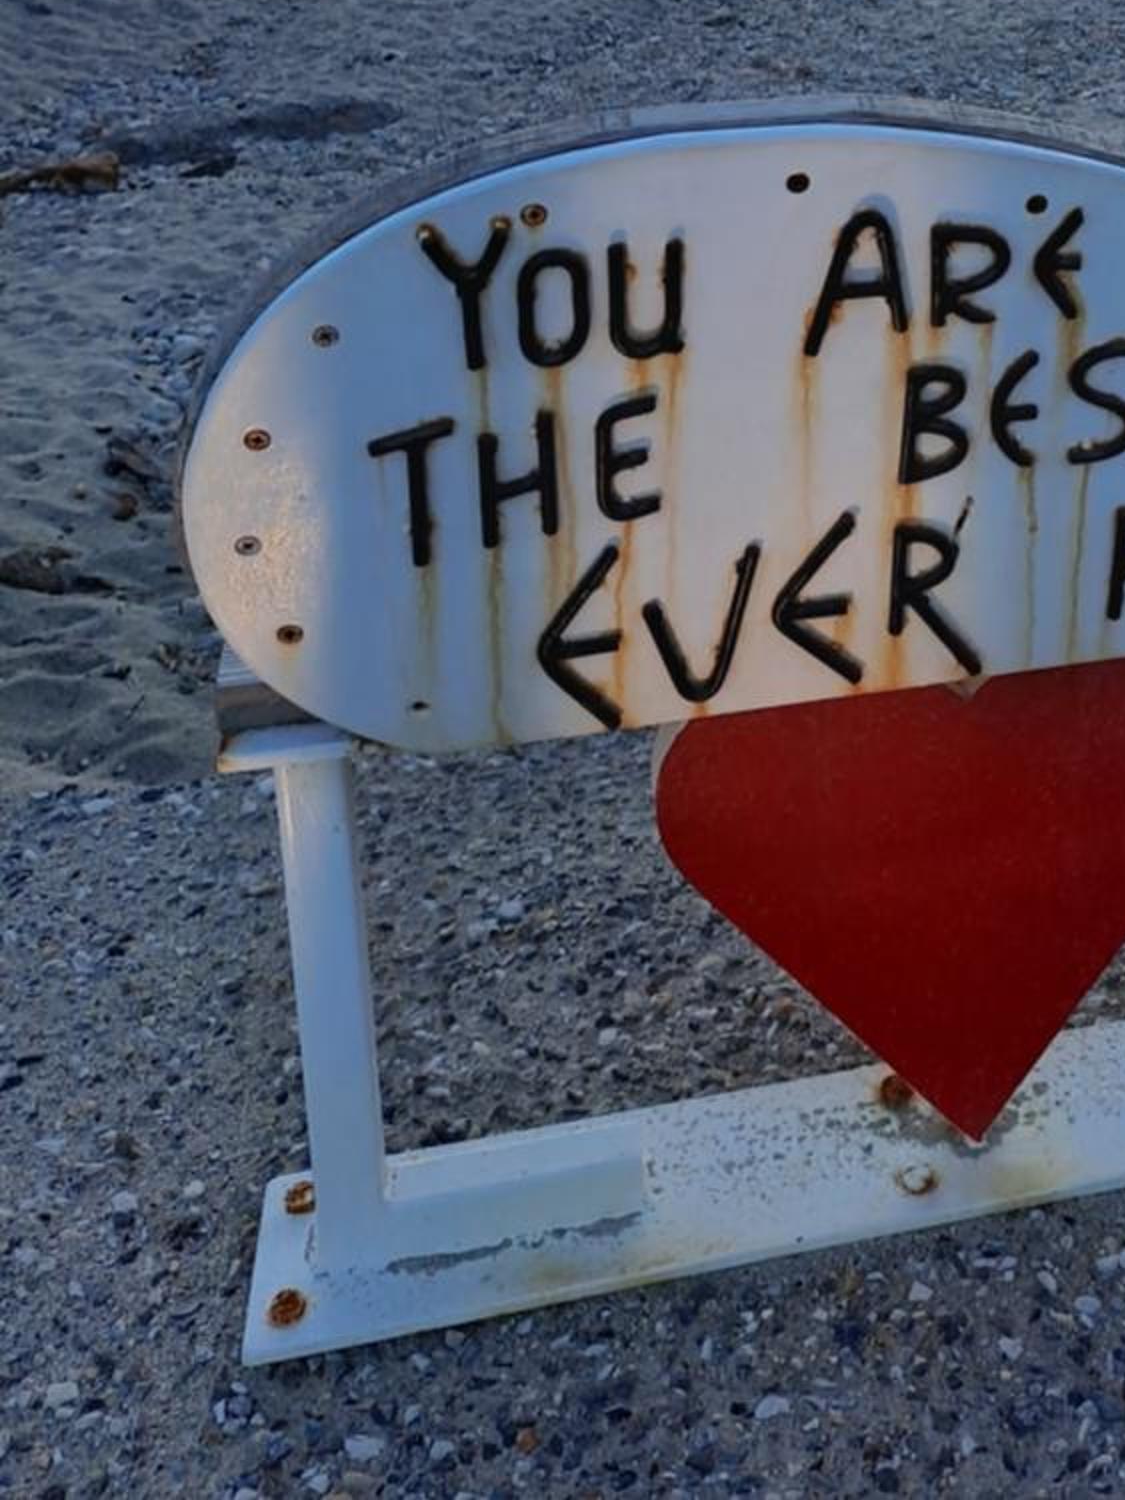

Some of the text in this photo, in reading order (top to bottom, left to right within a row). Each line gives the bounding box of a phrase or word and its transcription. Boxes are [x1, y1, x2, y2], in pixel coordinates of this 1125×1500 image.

[416, 206, 1085, 371] YOU ARE
[366, 392, 663, 568] THE
[536, 505, 984, 730] EVER
